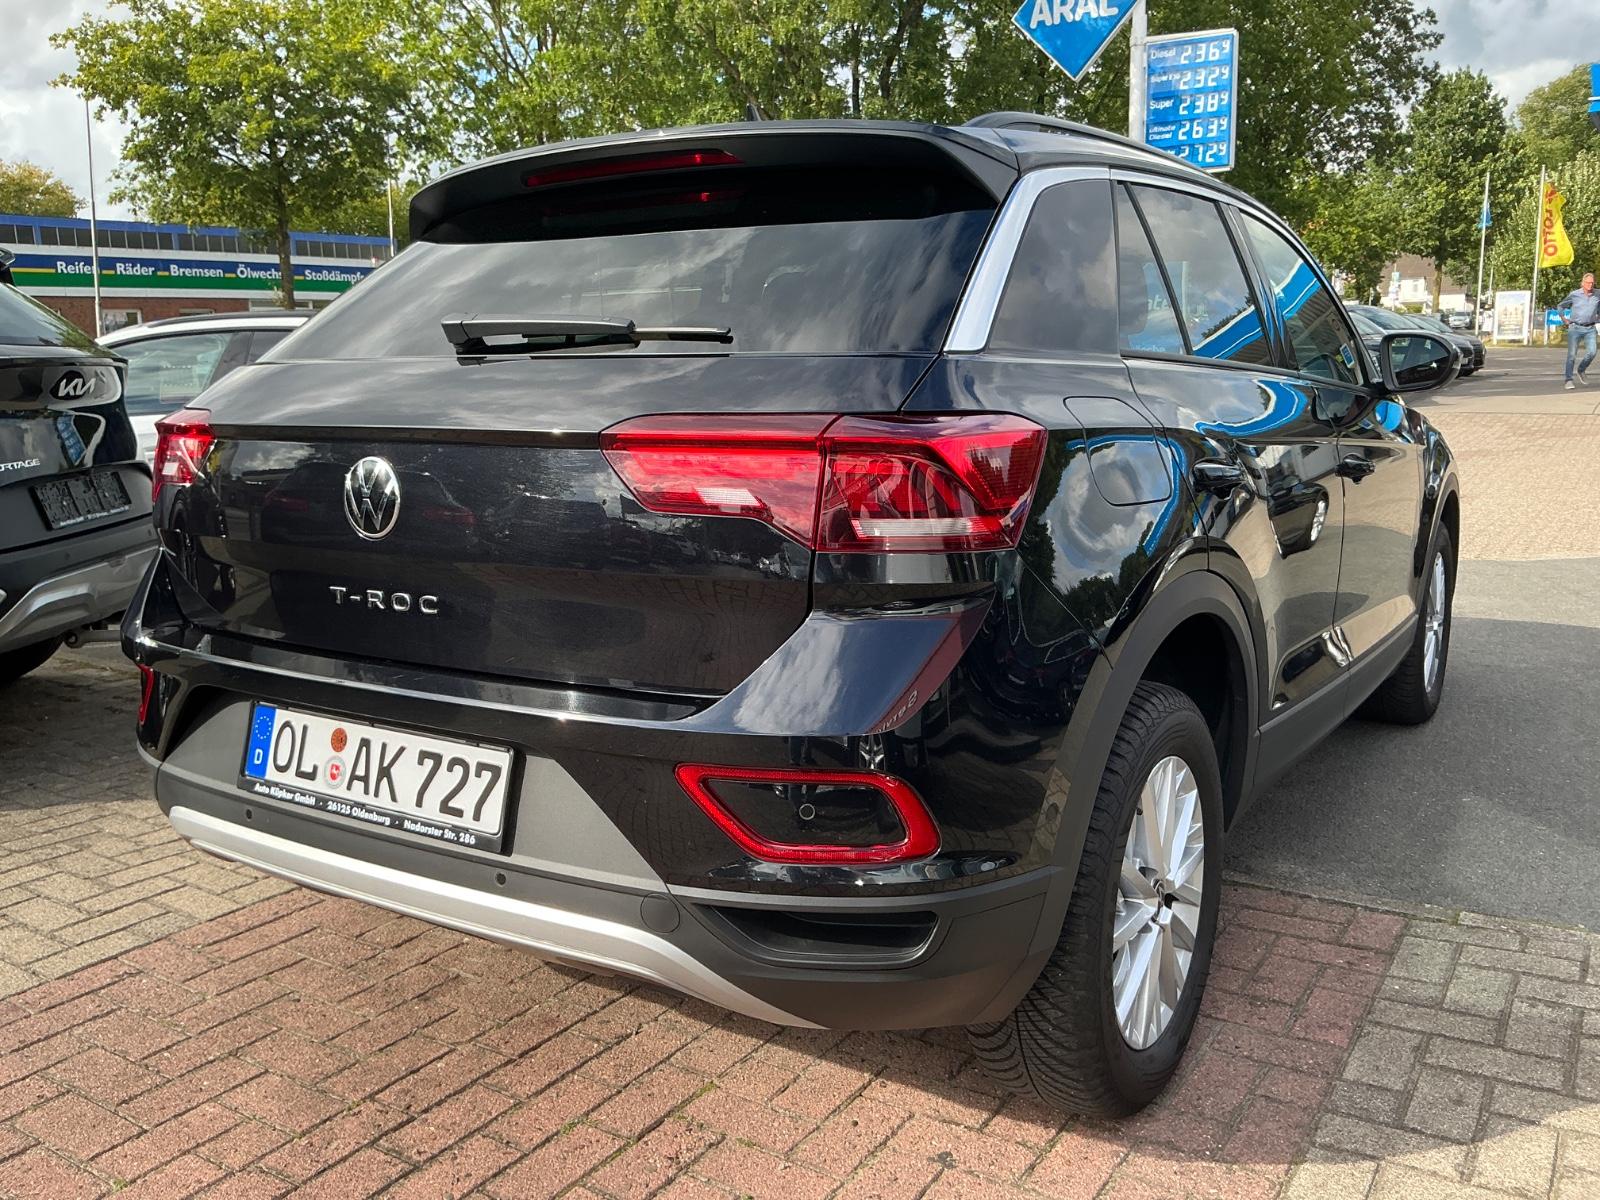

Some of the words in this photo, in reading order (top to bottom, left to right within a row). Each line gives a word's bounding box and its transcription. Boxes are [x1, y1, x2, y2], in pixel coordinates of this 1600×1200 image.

[1030, 0, 1119, 29] ARAL
[1151, 48, 1176, 59] Diesel
[1150, 99, 1174, 110] Super
[1149, 132, 1173, 140] Diesel
[116, 262, 155, 276] Räder
[170, 264, 224, 278] Bremsen
[328, 585, 440, 615] T-ROC
[253, 748, 263, 765] D
[272, 720, 319, 781] OL
[346, 737, 407, 803] AK
[415, 749, 503, 822] 727
[254, 783, 270, 794] Auto
[294, 793, 316, 805] GmbH
[326, 801, 351, 814] 26125
[351, 807, 391, 826] Oldenburg
[403, 820, 442, 837] Nadorster
[444, 829, 458, 841] Str.
[459, 832, 476, 845] 286
